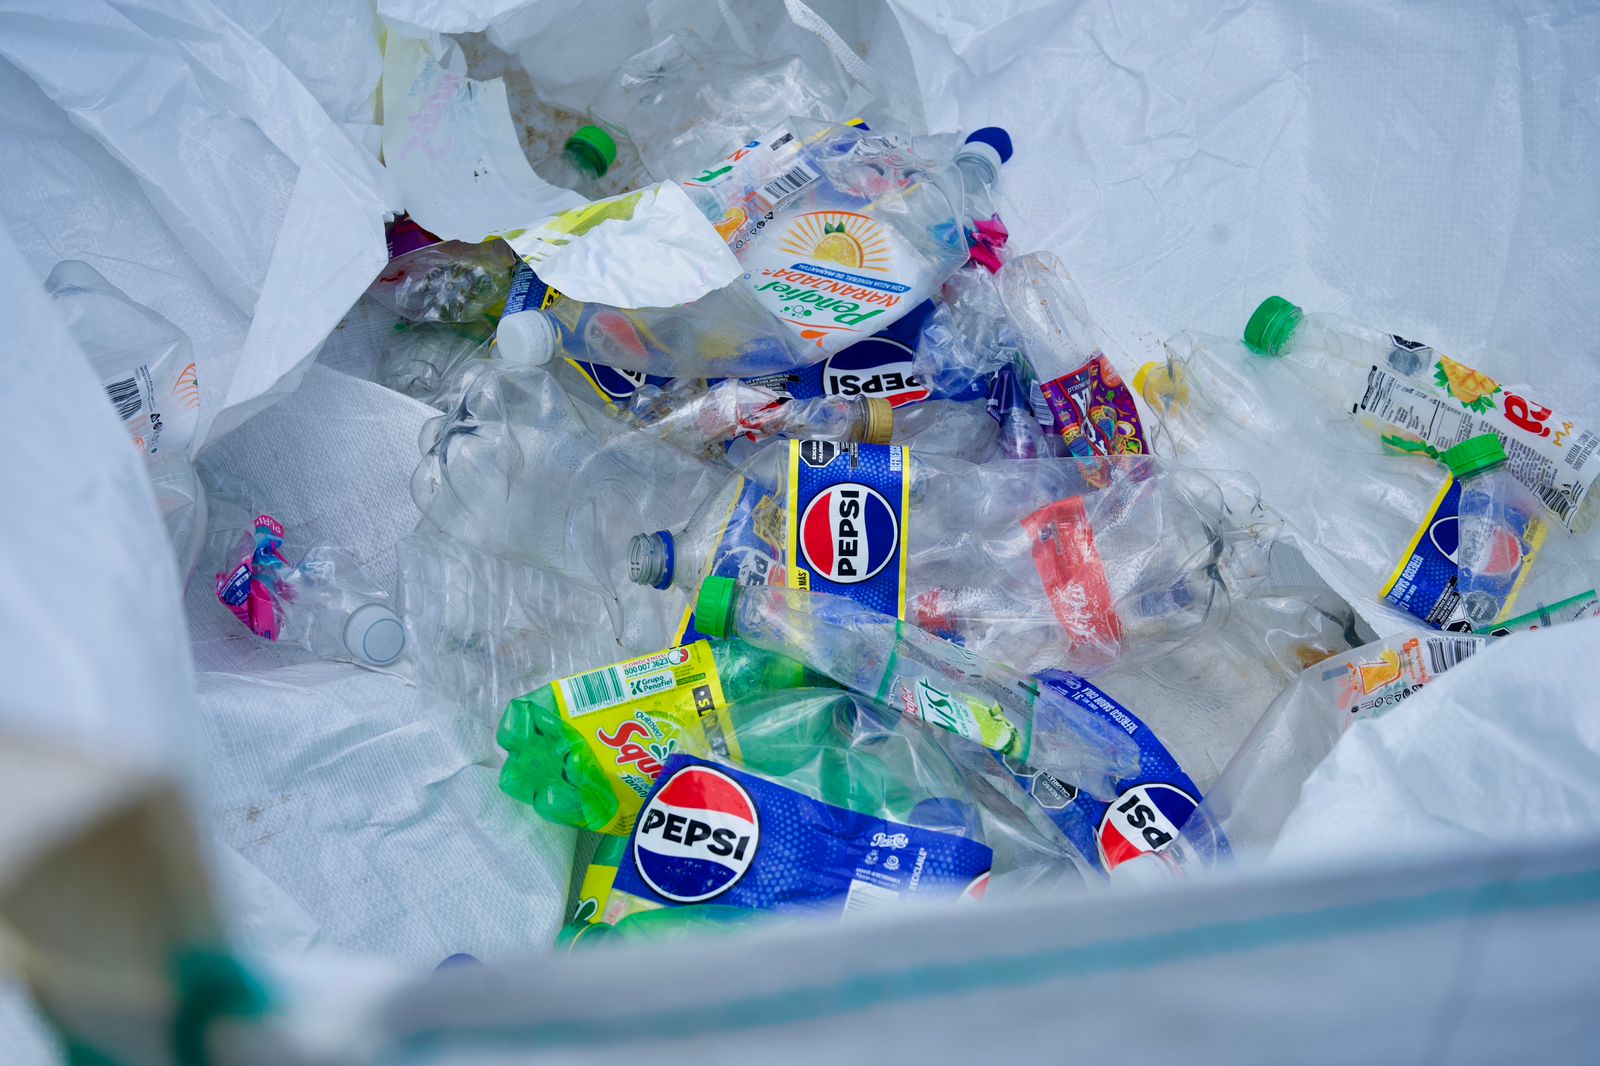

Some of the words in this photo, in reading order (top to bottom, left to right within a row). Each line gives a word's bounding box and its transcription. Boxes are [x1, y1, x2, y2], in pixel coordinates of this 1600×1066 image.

[798, 263, 835, 278] MANANTIAL
[774, 268, 902, 308] NARANJADA
[845, 275, 874, 287] MINERAL
[874, 280, 890, 290] AGUA
[890, 284, 904, 293] CON
[756, 280, 886, 326] Peñafiel
[255, 514, 282, 533] PURI
[837, 490, 860, 577] PEPSI
[624, 667, 638, 676] 800
[638, 663, 650, 671] 007
[652, 658, 668, 668] 3623
[642, 676, 664, 685] Grupo
[1094, 697, 1115, 712] SABOR
[1042, 780, 1062, 801] EXCESO
[642, 808, 751, 860] PEPSI
